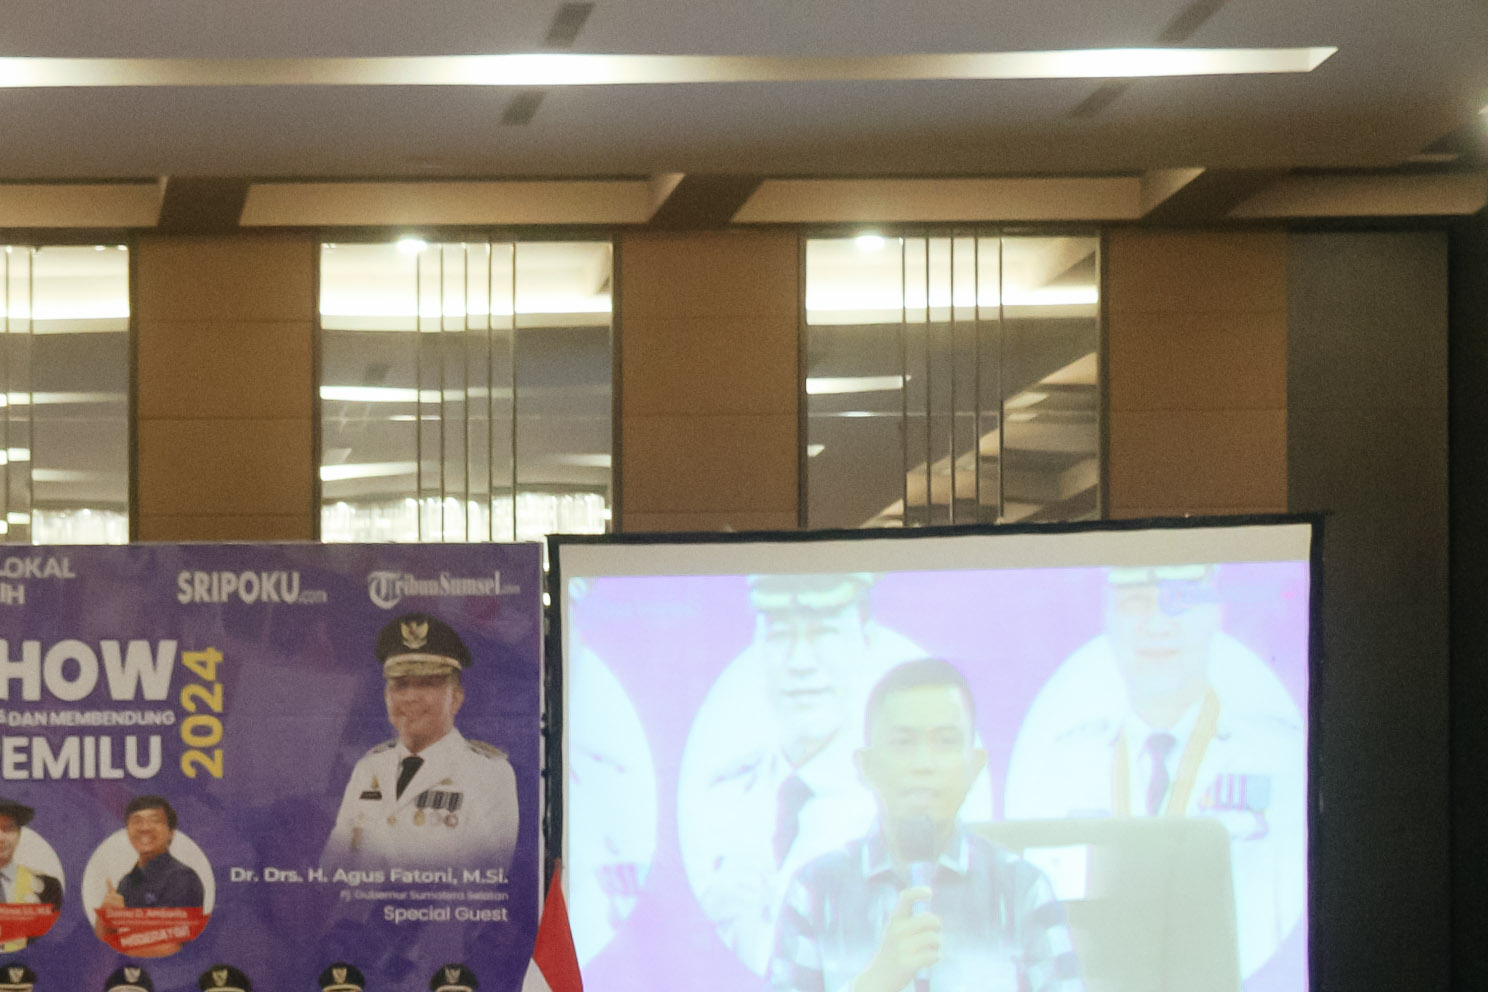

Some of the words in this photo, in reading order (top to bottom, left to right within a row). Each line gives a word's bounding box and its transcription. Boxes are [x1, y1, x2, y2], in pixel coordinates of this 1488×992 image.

[8, 711, 48, 726] DAN
[50, 710, 176, 726] MEMBENDUNG
[180, 647, 224, 779] 2024
[230, 867, 259, 883] Dr.
[264, 867, 303, 883] Drs.
[308, 868, 328, 883] H.
[333, 868, 385, 886] Agus
[390, 868, 457, 885] Fatoni,
[463, 868, 509, 884] M.Si.
[384, 905, 450, 924] Special
[455, 905, 509, 922] Guest
